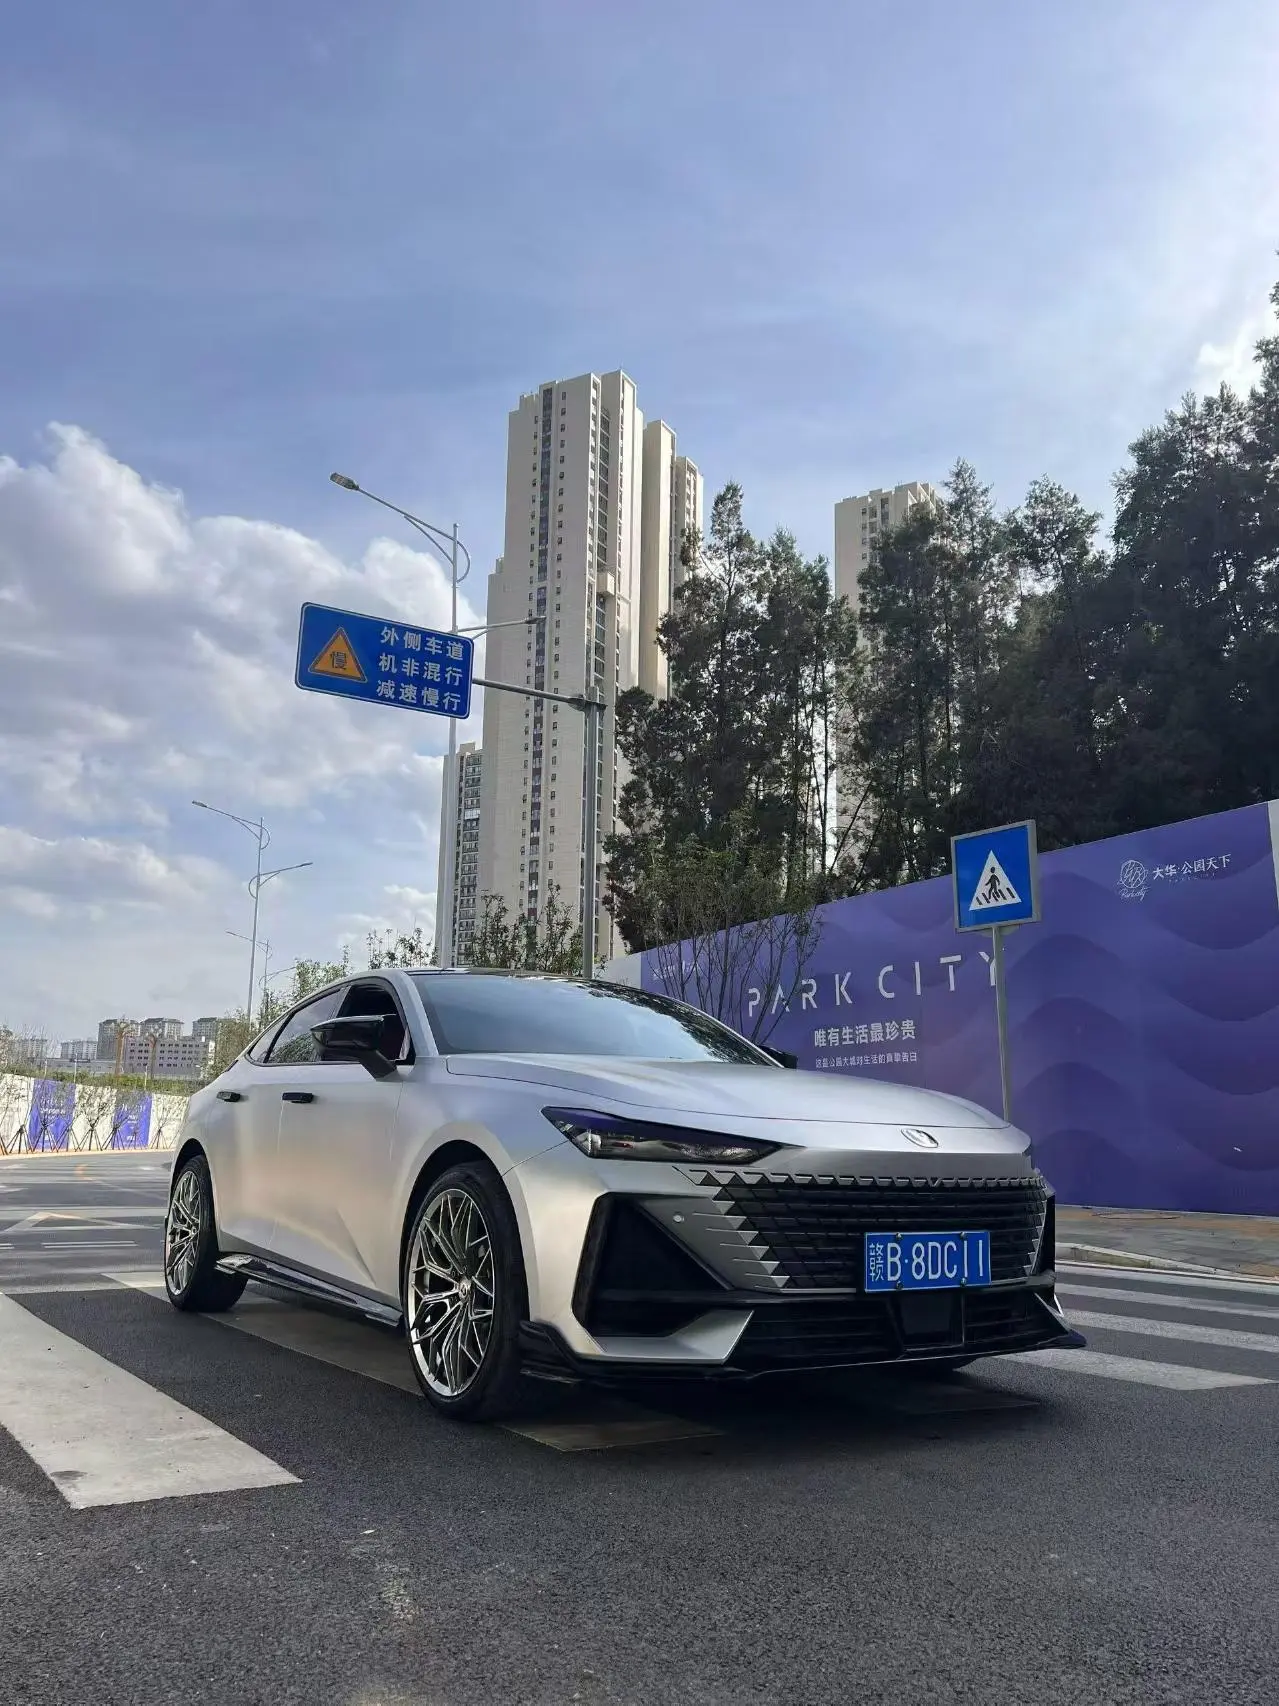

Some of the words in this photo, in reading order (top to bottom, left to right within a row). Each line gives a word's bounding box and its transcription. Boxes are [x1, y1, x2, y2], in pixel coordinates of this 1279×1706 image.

[380, 627, 463, 661] 外侧车道
[329, 651, 347, 670] 慢
[378, 653, 462, 686] 机非混行
[376, 680, 460, 711] 减速慢行
[1152, 854, 1231, 880] 大华·公园天下
[748, 972, 852, 1017] PARK
[878, 951, 998, 999] CITY
[814, 1019, 916, 1048] 唯有生活最珍贵
